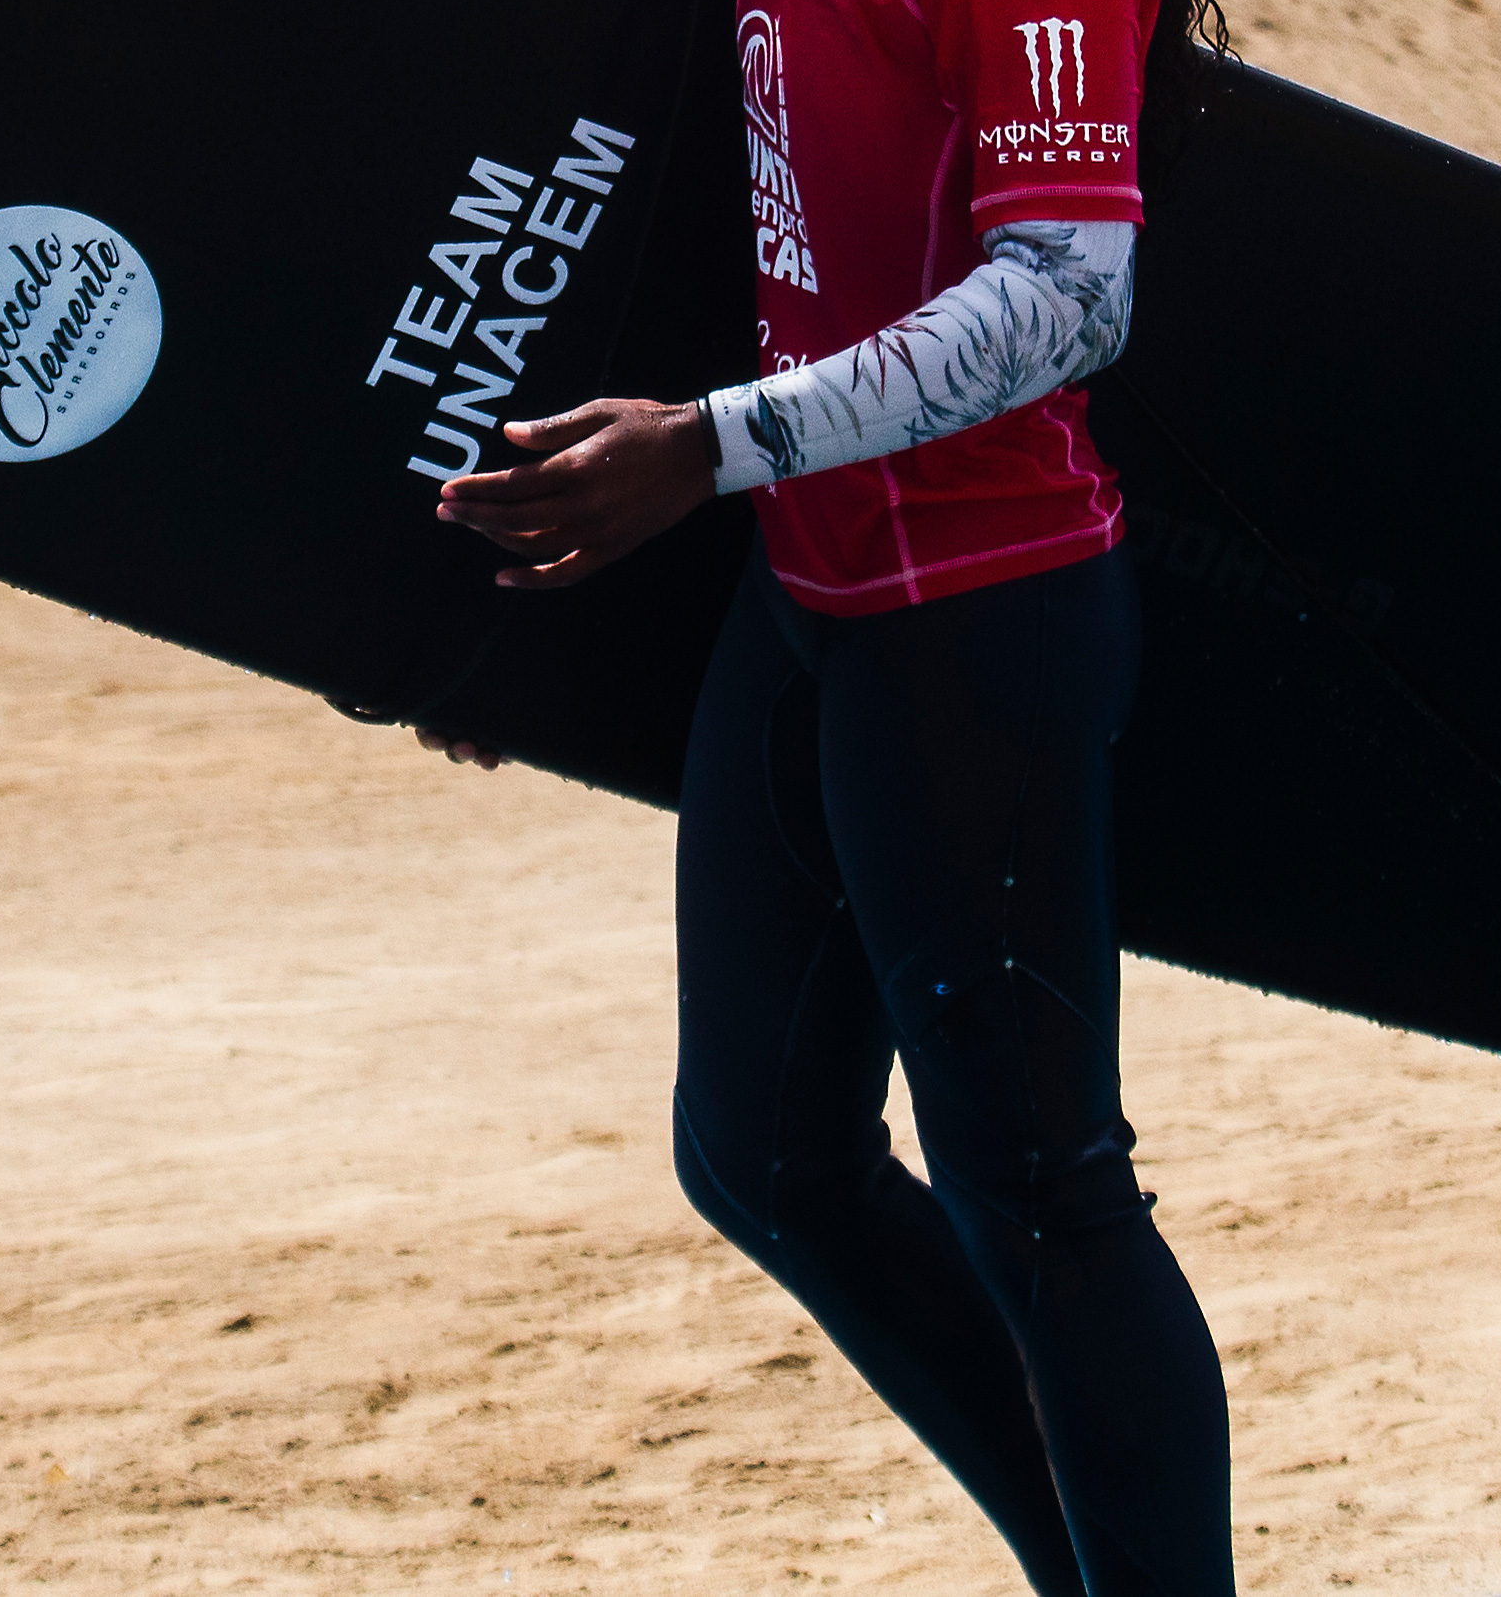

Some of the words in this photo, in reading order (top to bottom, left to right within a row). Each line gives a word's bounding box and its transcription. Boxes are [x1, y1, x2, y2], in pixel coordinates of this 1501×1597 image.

[979, 118, 1131, 149] MONSTER
[998, 150, 1121, 164] ENERGY
[364, 155, 535, 388] TEAM
[407, 117, 636, 483] UNACEM
[756, 226, 819, 295] CAS
[56, 270, 136, 414] SURFBOARDS
